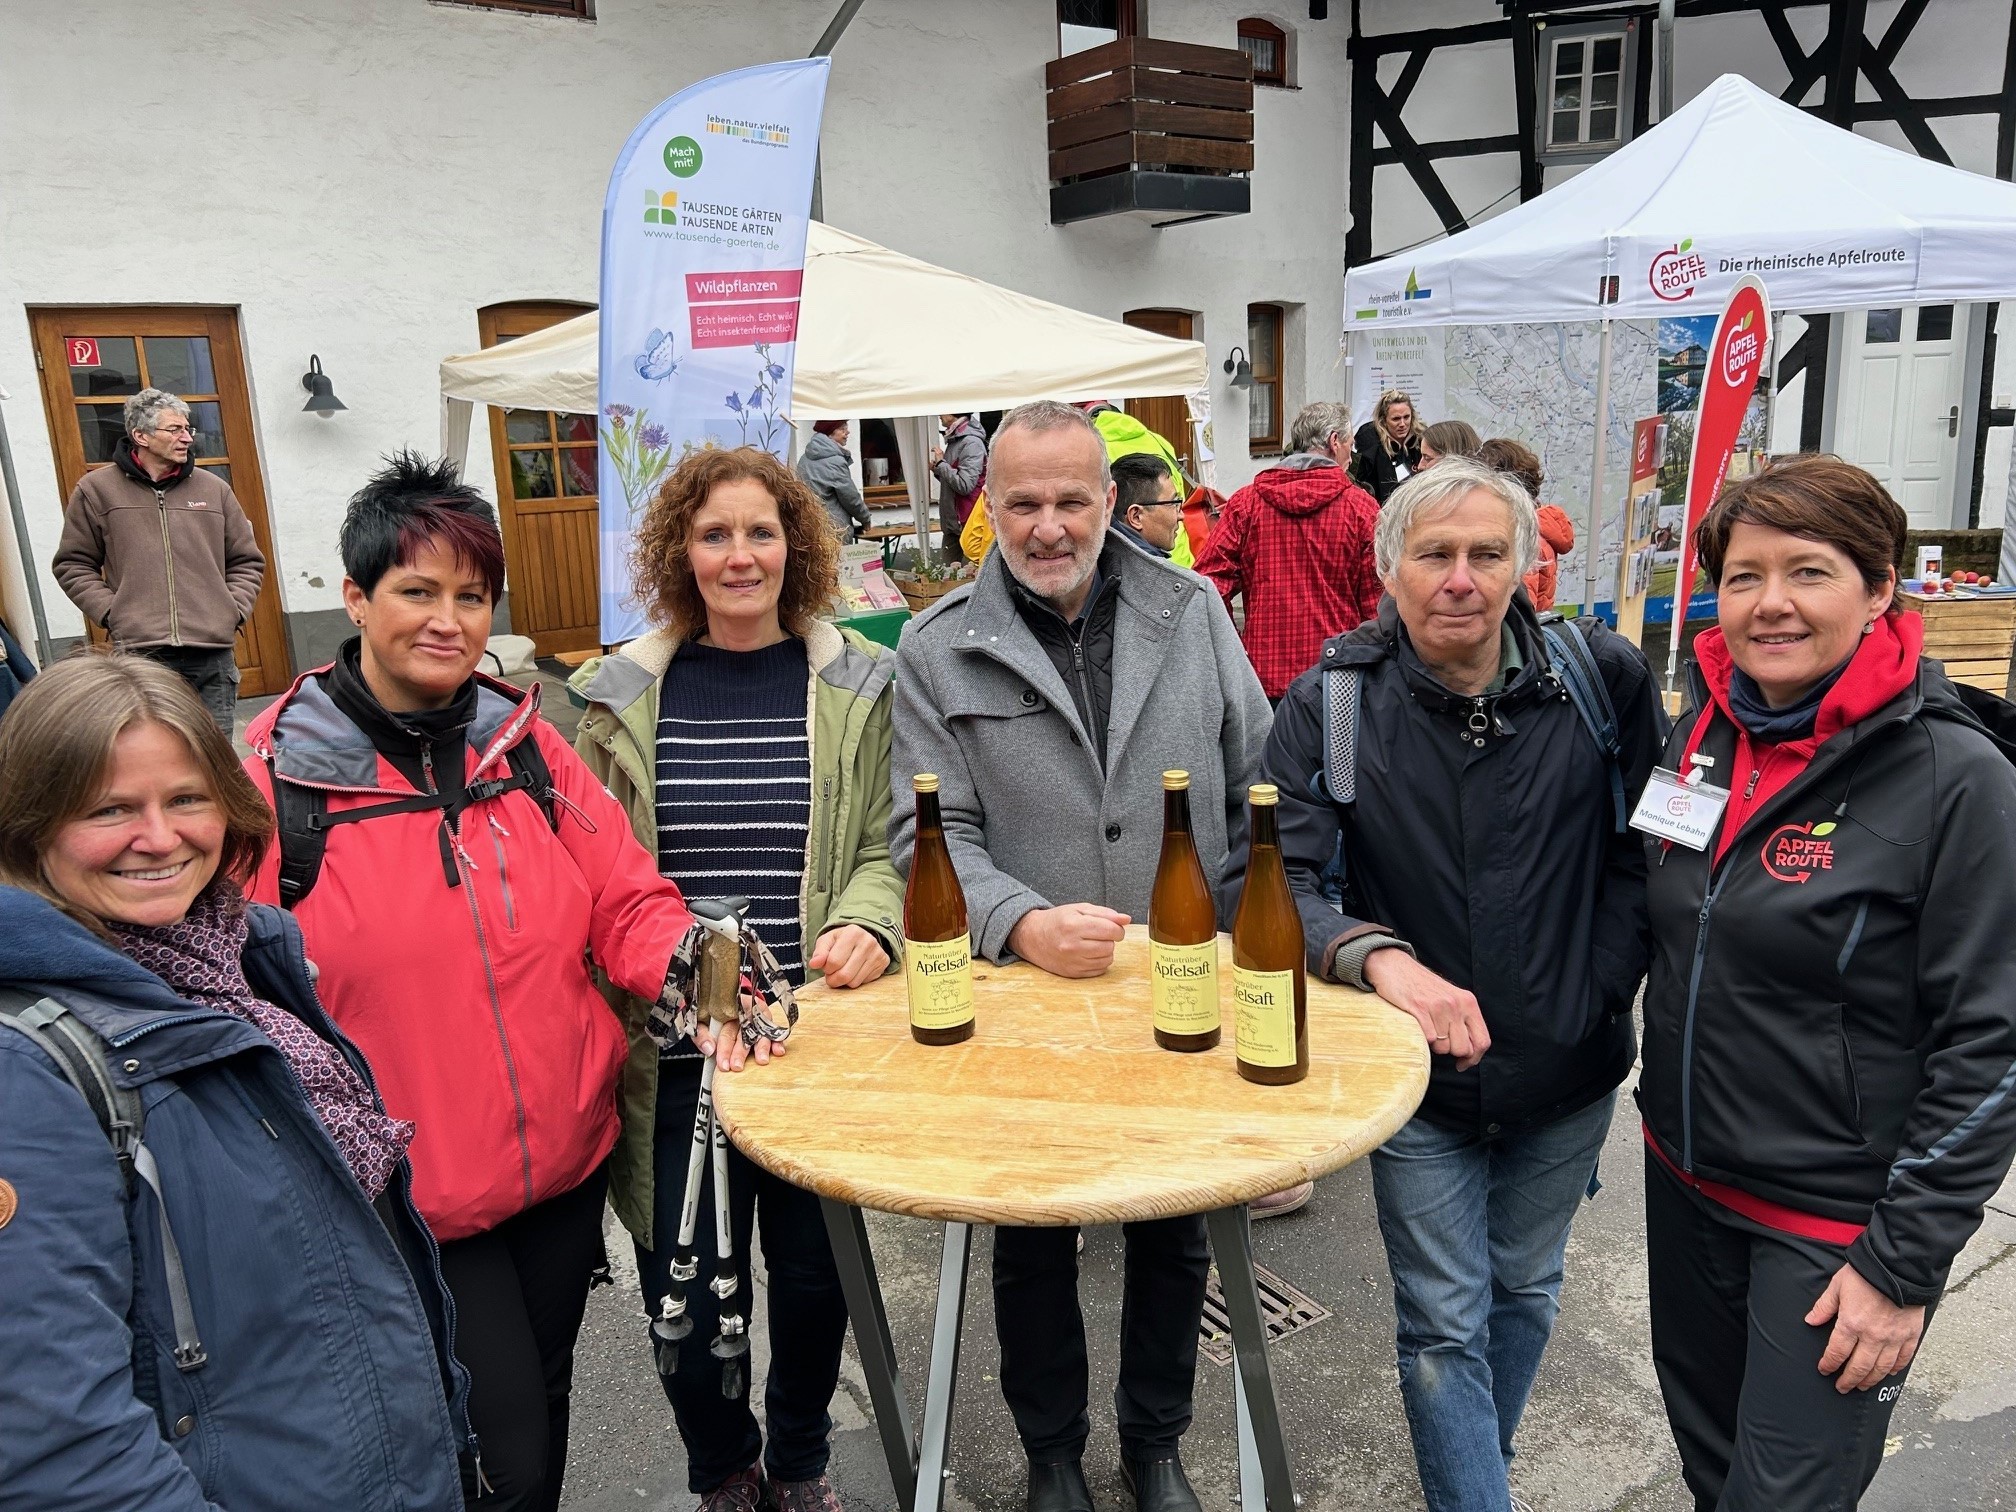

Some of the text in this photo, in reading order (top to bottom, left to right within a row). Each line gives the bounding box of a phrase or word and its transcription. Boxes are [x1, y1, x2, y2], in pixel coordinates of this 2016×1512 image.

[707, 114, 790, 134] leben.natur.vielfalt
[669, 146, 695, 158] Mach
[674, 157, 694, 168] mit!
[682, 201, 782, 223] TAUSENDE GÄRTEN
[682, 216, 774, 236] TAUSENDE ARTEN
[643, 229, 780, 251] www.tausende-gaerten.de
[1660, 254, 1706, 278] APFEL
[1718, 247, 1906, 274] Die rheinische Apfelroute
[1661, 266, 1708, 291] ROUTE
[695, 279, 778, 297] Wildpflanzen
[1368, 291, 1400, 304] rhein-voreifel
[696, 315, 716, 325] Echt
[717, 313, 757, 325] heimisch.
[758, 312, 776, 322] Echt
[1382, 305, 1404, 318] touristik
[697, 327, 717, 338] Echt
[1373, 335, 1428, 348] UNTERWEGS IN DER
[1730, 333, 1757, 357] APFEL
[1729, 346, 1757, 373] ROUTE
[1672, 800, 1691, 808] APFEL
[1639, 808, 1706, 839] Monique Lebahn
[1776, 837, 1835, 855] APFEL
[1775, 852, 1833, 870] ROUTE
[923, 948, 963, 960] Naturtrüber
[1160, 955, 1202, 964] Naturtrüber
[916, 953, 969, 976] Apfelsaft
[1154, 960, 1210, 978] Apfelsaft
[693, 1086, 712, 1145] LEKI
